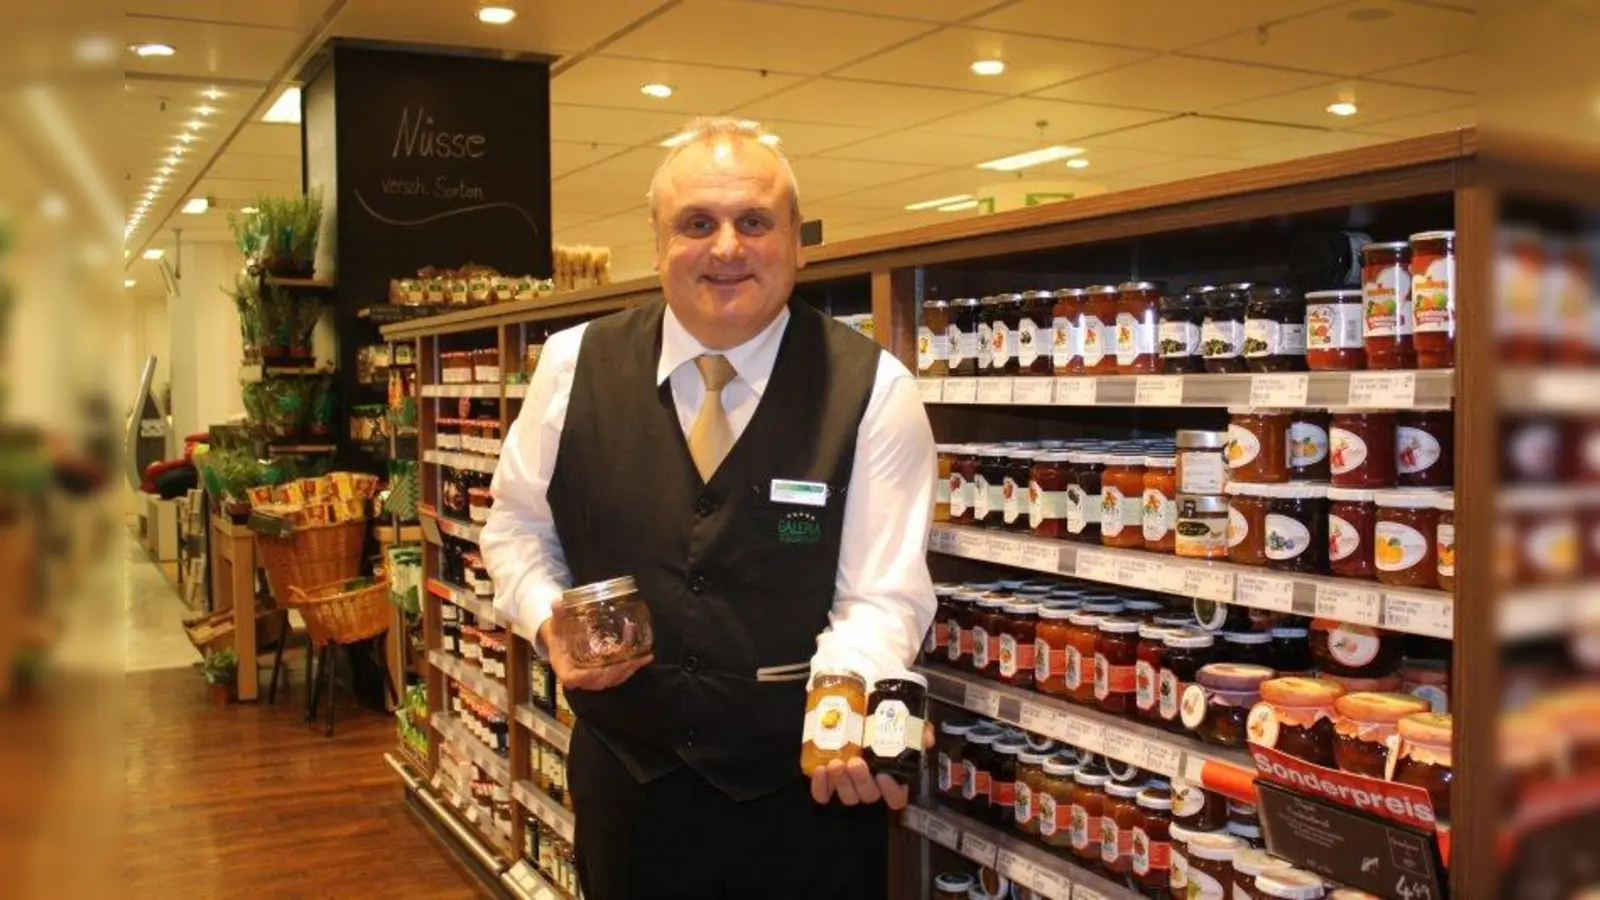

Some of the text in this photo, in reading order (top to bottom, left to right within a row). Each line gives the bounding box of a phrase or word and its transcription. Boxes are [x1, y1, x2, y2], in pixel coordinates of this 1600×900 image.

[392, 107, 487, 158] Nüsse
[434, 175, 484, 199] Sorten
[1254, 753, 1435, 822] Sonderpreis
